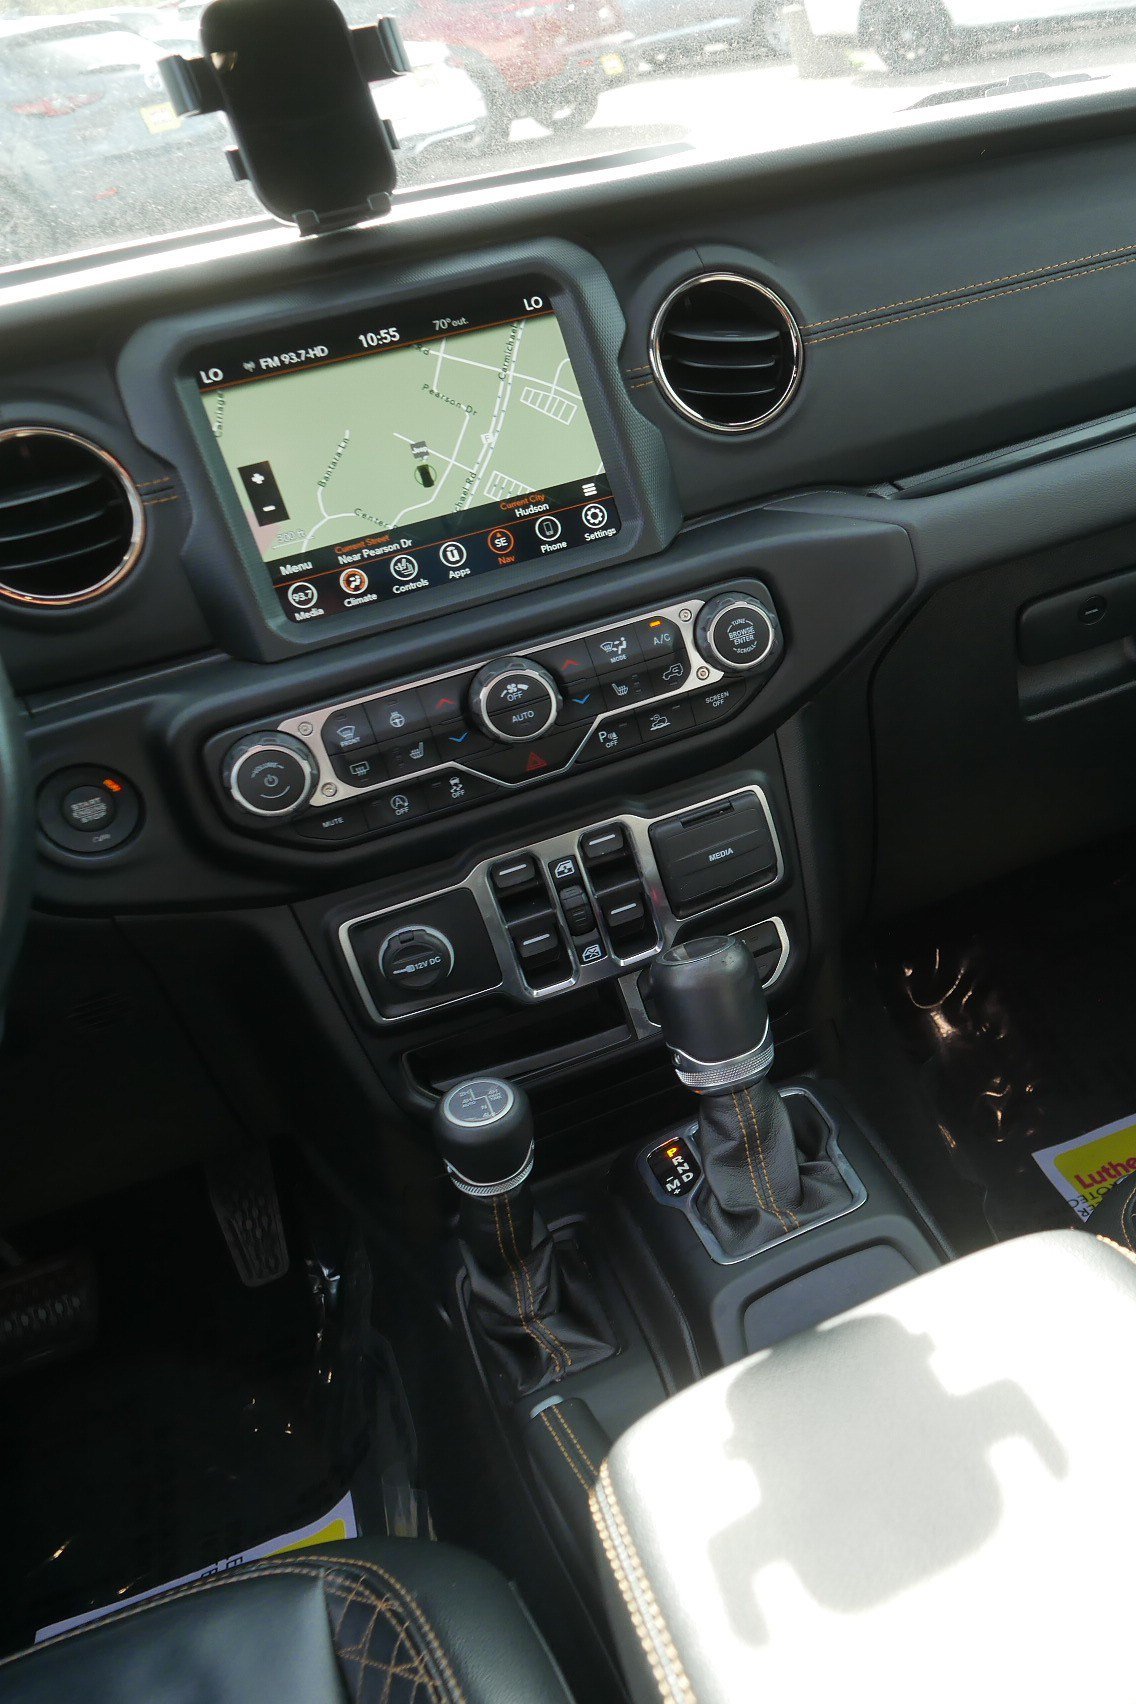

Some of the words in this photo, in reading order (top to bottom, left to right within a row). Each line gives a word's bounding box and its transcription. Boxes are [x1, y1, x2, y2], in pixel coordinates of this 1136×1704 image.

[523, 296, 543, 311] LO
[358, 327, 400, 348] 10:55
[498, 323, 519, 380] Carmichael
[259, 356, 281, 370] FM
[200, 368, 224, 384] LO
[422, 383, 462, 408] Pearson
[465, 404, 478, 416] Dr
[500, 499, 530, 510] Current
[530, 494, 545, 507] City
[515, 502, 549, 518] Hudson
[583, 527, 617, 542] Settings
[334, 540, 366, 554] Current
[366, 534, 391, 548] Street
[540, 540, 567, 554] Phone
[337, 552, 362, 565] Near
[362, 543, 401, 560] Pearson
[400, 538, 413, 551] Dr
[497, 555, 515, 565] Nav
[279, 560, 313, 576] Menu
[448, 568, 471, 580] Apps
[392, 579, 429, 594] Controls
[343, 593, 378, 608] Climate
[294, 607, 325, 622] Media
[653, 633, 671, 645] A/C
[728, 626, 755, 639] BROWSE
[734, 634, 755, 645] ENTER
[610, 653, 628, 664] MODE
[506, 689, 523, 702] OFF
[705, 690, 730, 705] SCREEN
[712, 699, 725, 708] OFF
[511, 710, 535, 723] AUTO
[605, 739, 619, 749] OFF
[451, 789, 466, 799] OFF
[395, 806, 410, 816] OFF
[322, 816, 345, 828] MUTE
[709, 847, 734, 862] MEDIA
[415, 960, 428, 970] 12V
[429, 956, 441, 966] DC
[666, 1147, 678, 1158] P
[671, 1155, 685, 1166] R
[676, 1162, 690, 1174] N
[681, 1172, 694, 1183] D
[665, 1178, 681, 1192] M
